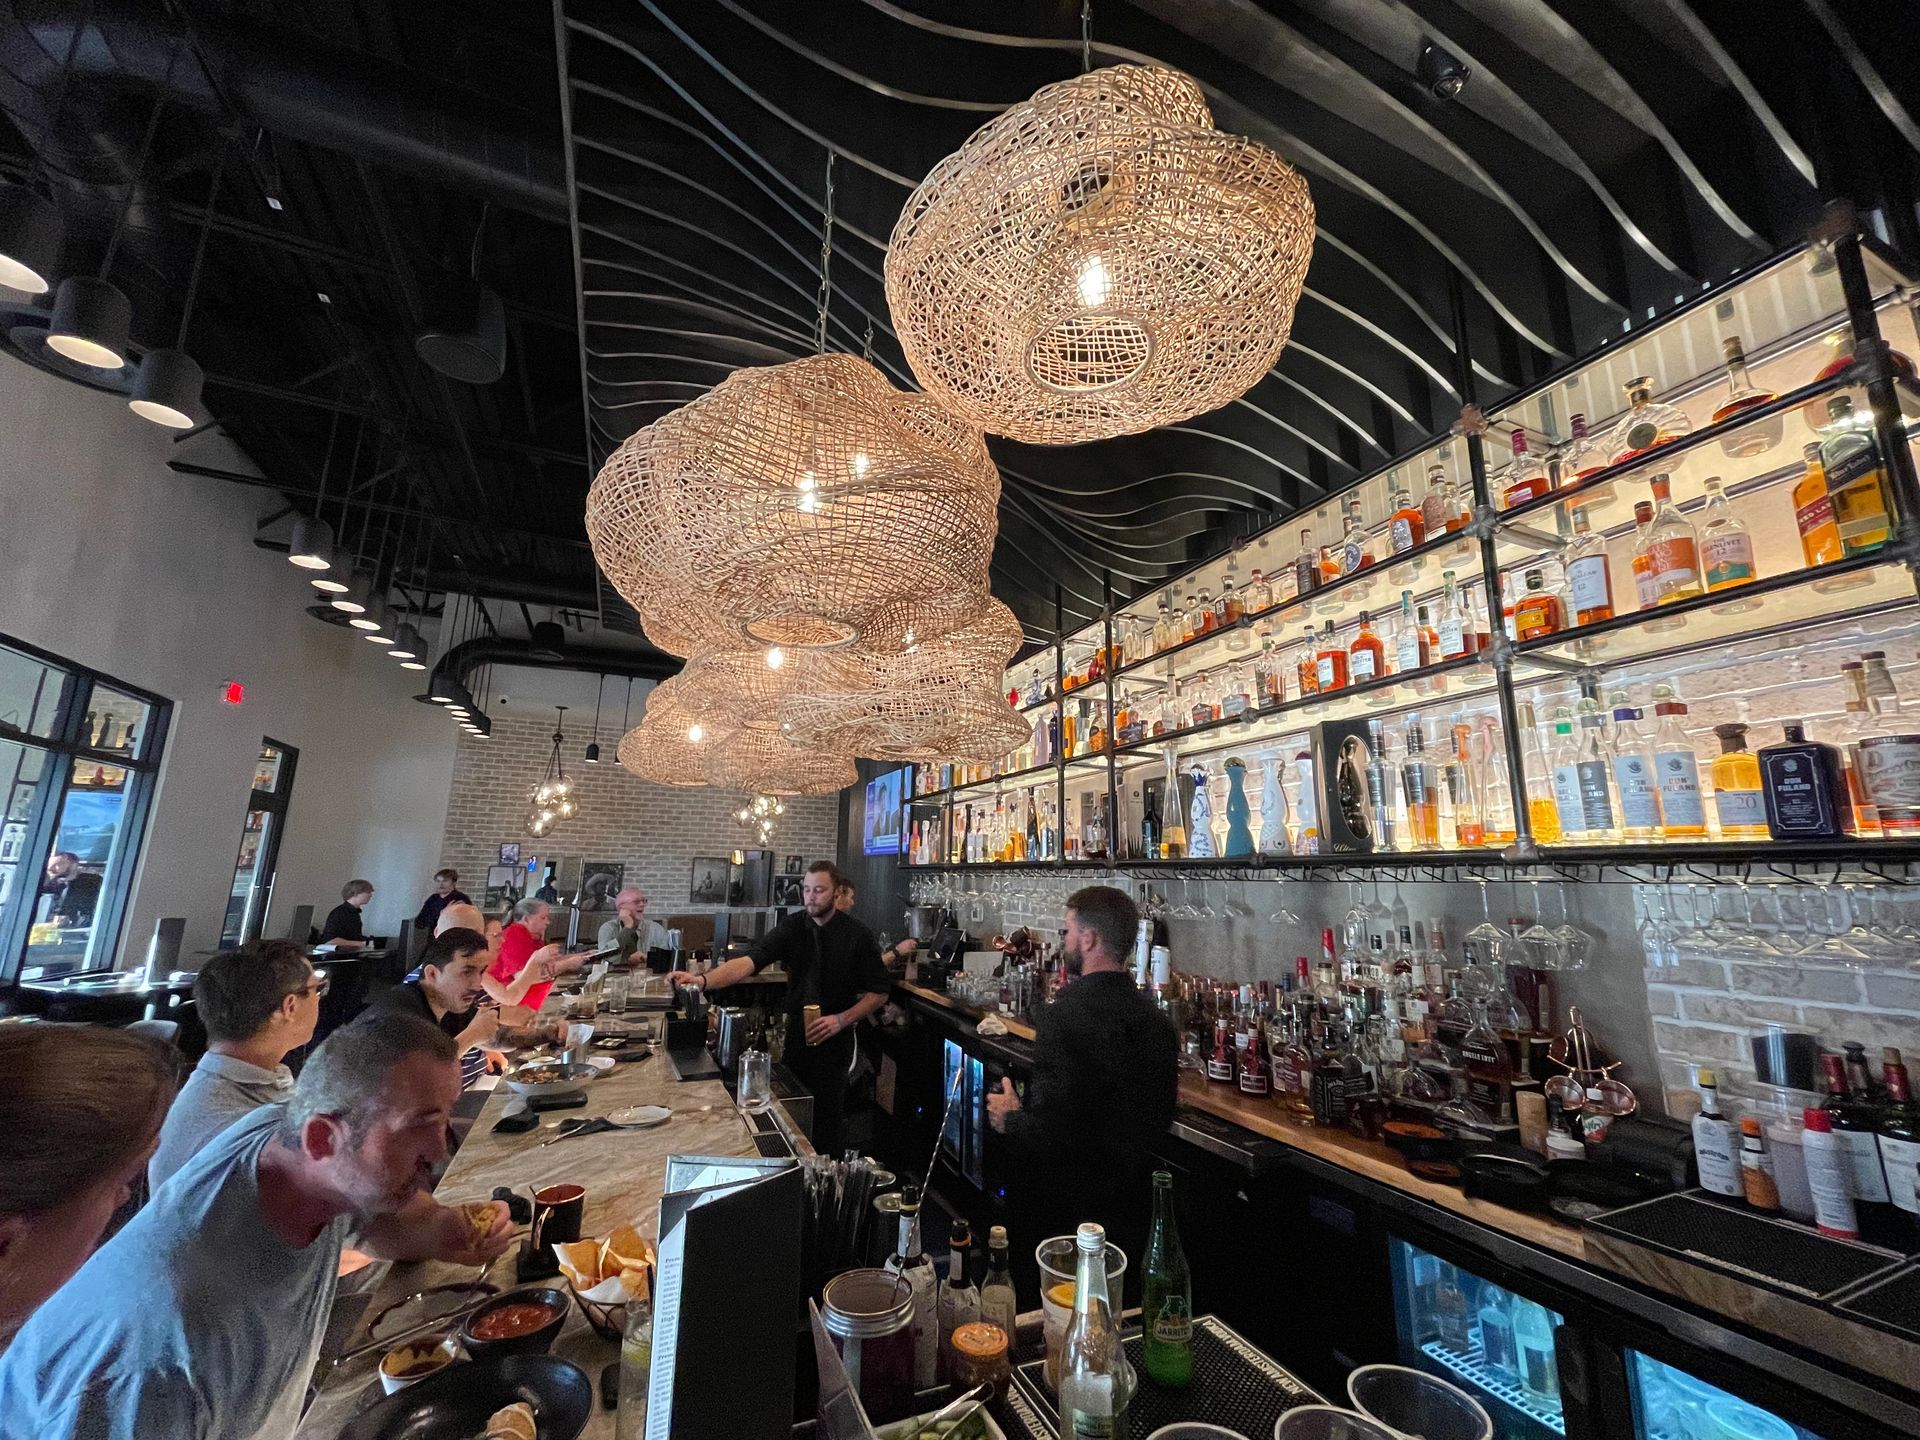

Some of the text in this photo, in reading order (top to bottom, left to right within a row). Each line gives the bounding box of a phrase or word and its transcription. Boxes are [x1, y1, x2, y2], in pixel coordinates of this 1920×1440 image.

[1703, 539, 1741, 553] GLENLIVET
[1734, 795, 1757, 810] 20
[1202, 1319, 1237, 1346] VODKA
[1226, 1336, 1286, 1383] AMSTERDAM
